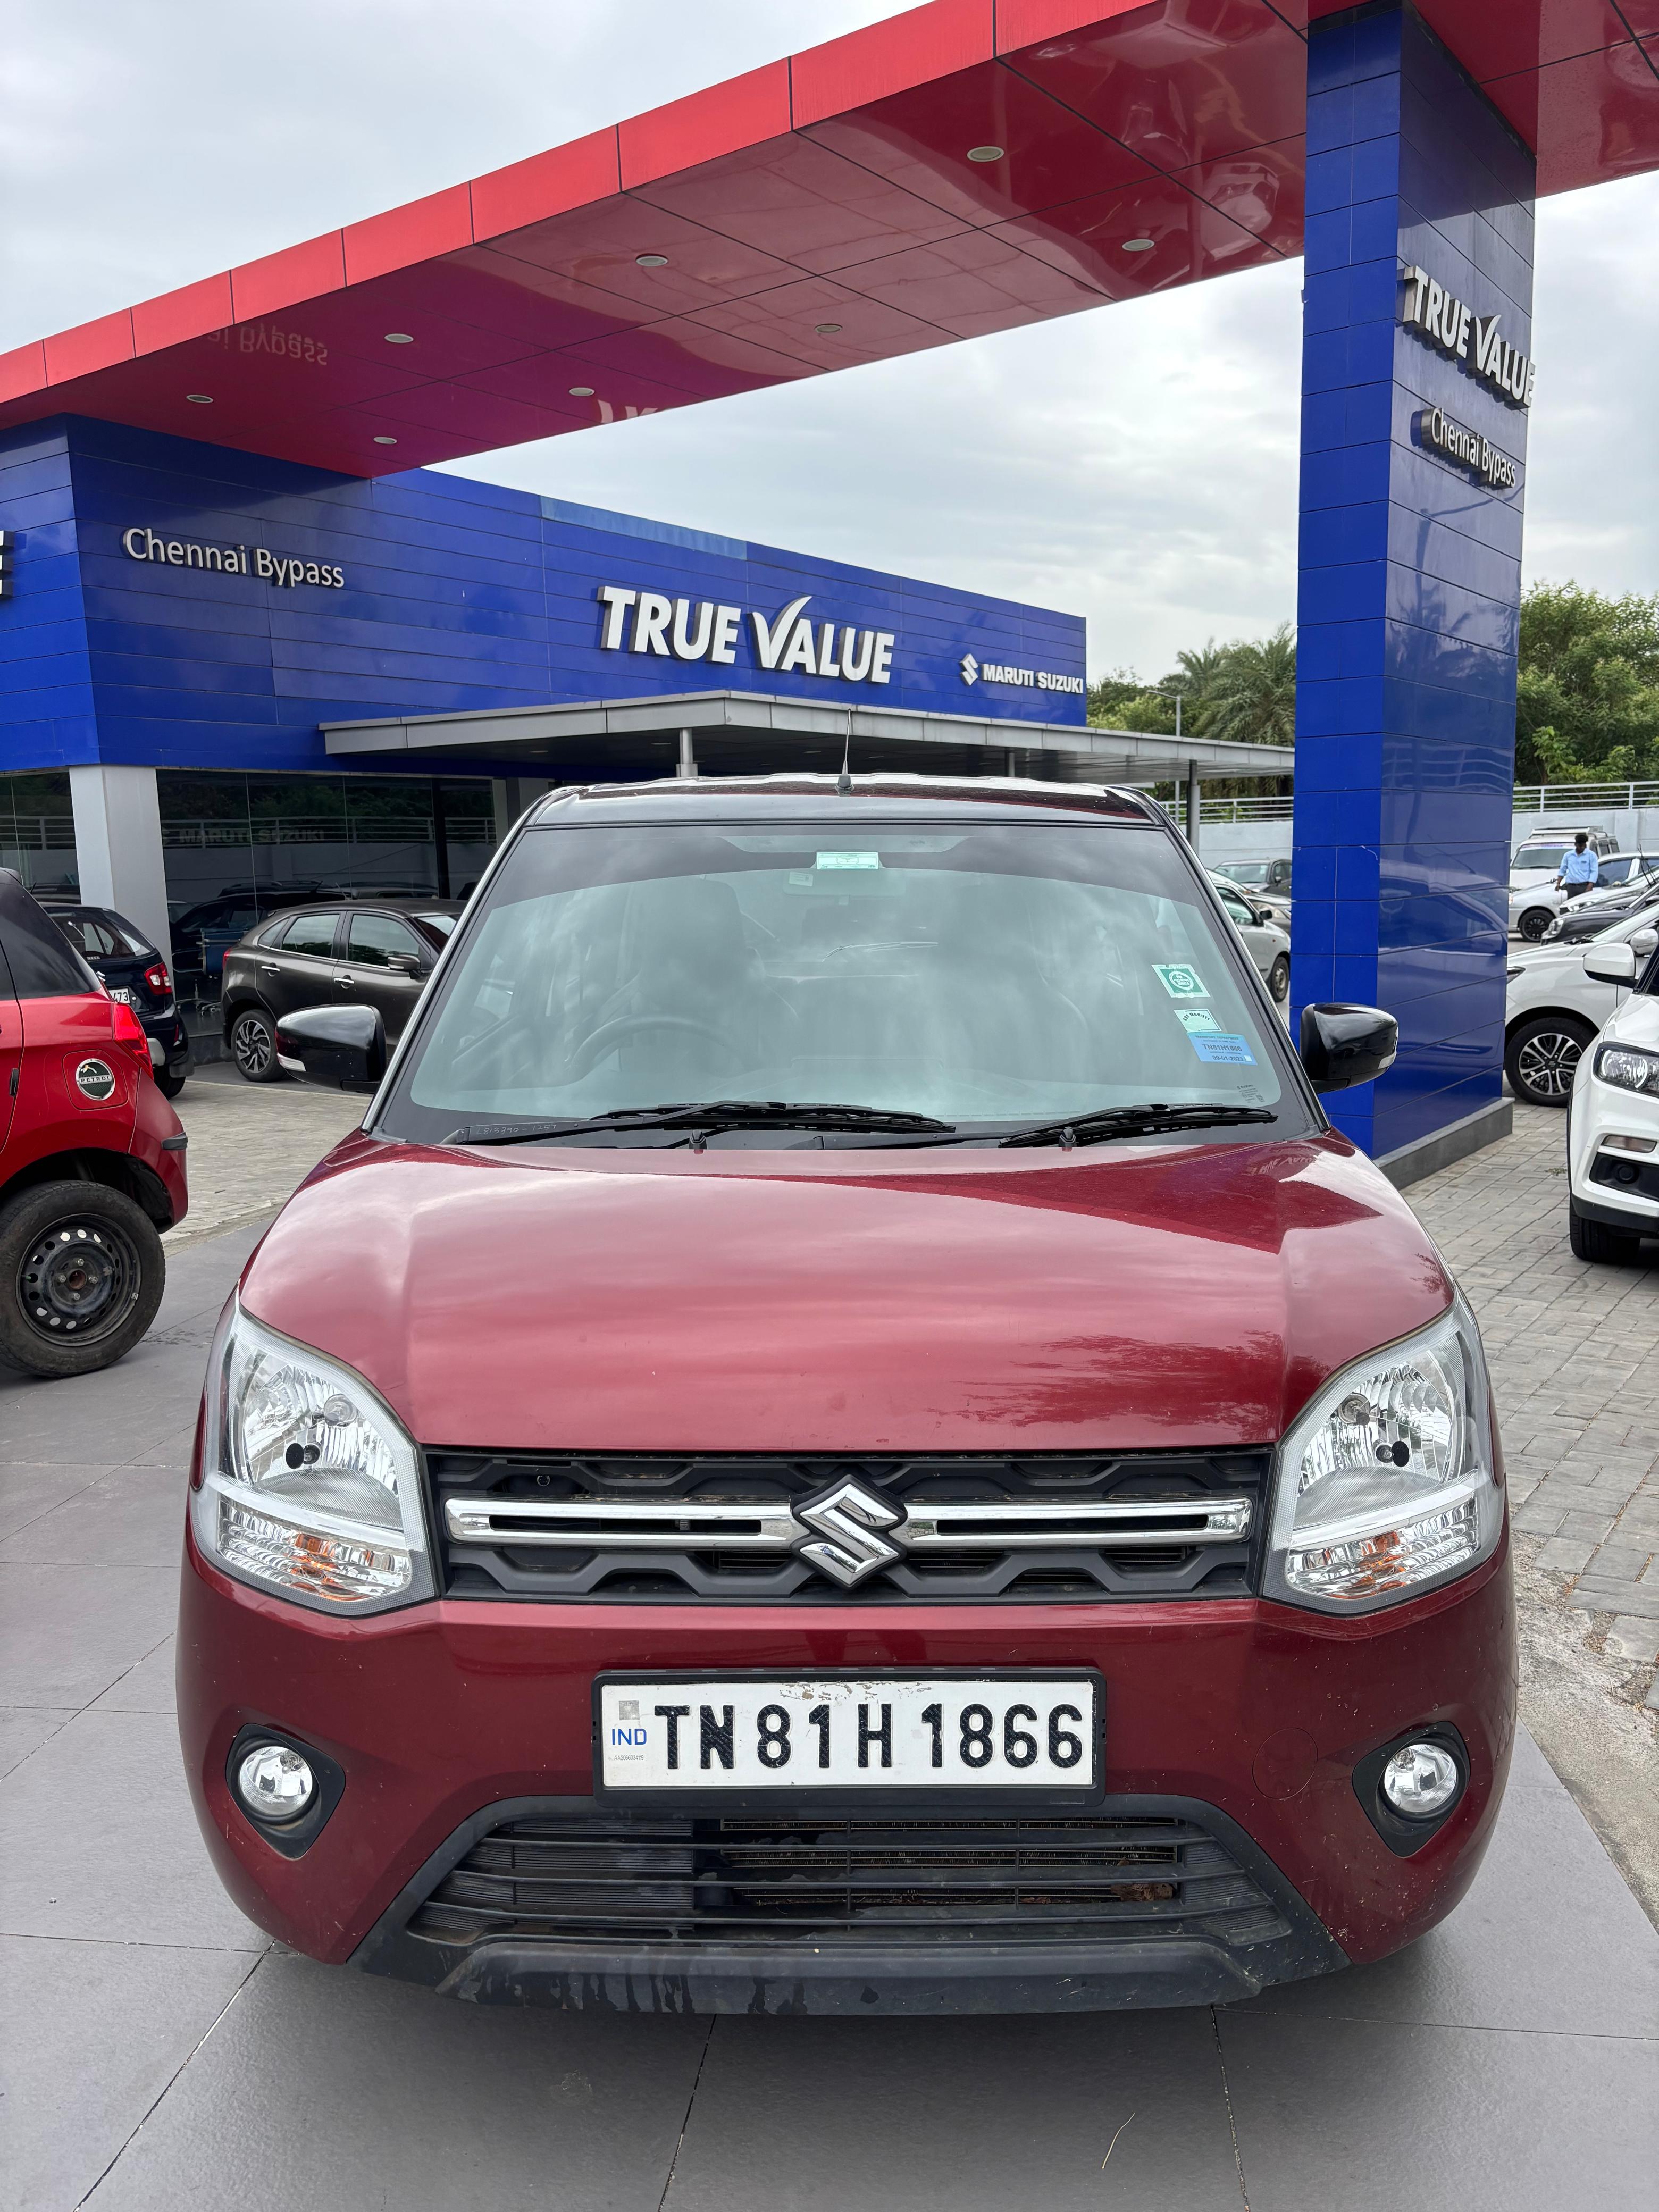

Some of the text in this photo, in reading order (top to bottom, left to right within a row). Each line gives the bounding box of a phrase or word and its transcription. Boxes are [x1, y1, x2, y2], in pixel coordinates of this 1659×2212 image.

[1408, 265, 1536, 409] TRUE VALUE
[1430, 408, 1516, 488] Chennai Bypass
[124, 527, 345, 588] Chennai Bypass
[598, 585, 895, 684] TRUE VALUE
[983, 664, 1084, 694] MARUTI SUZUKI
[81, 1075, 111, 1083] PETROL
[611, 1703, 1083, 1770] IND TN 81 H 1866
